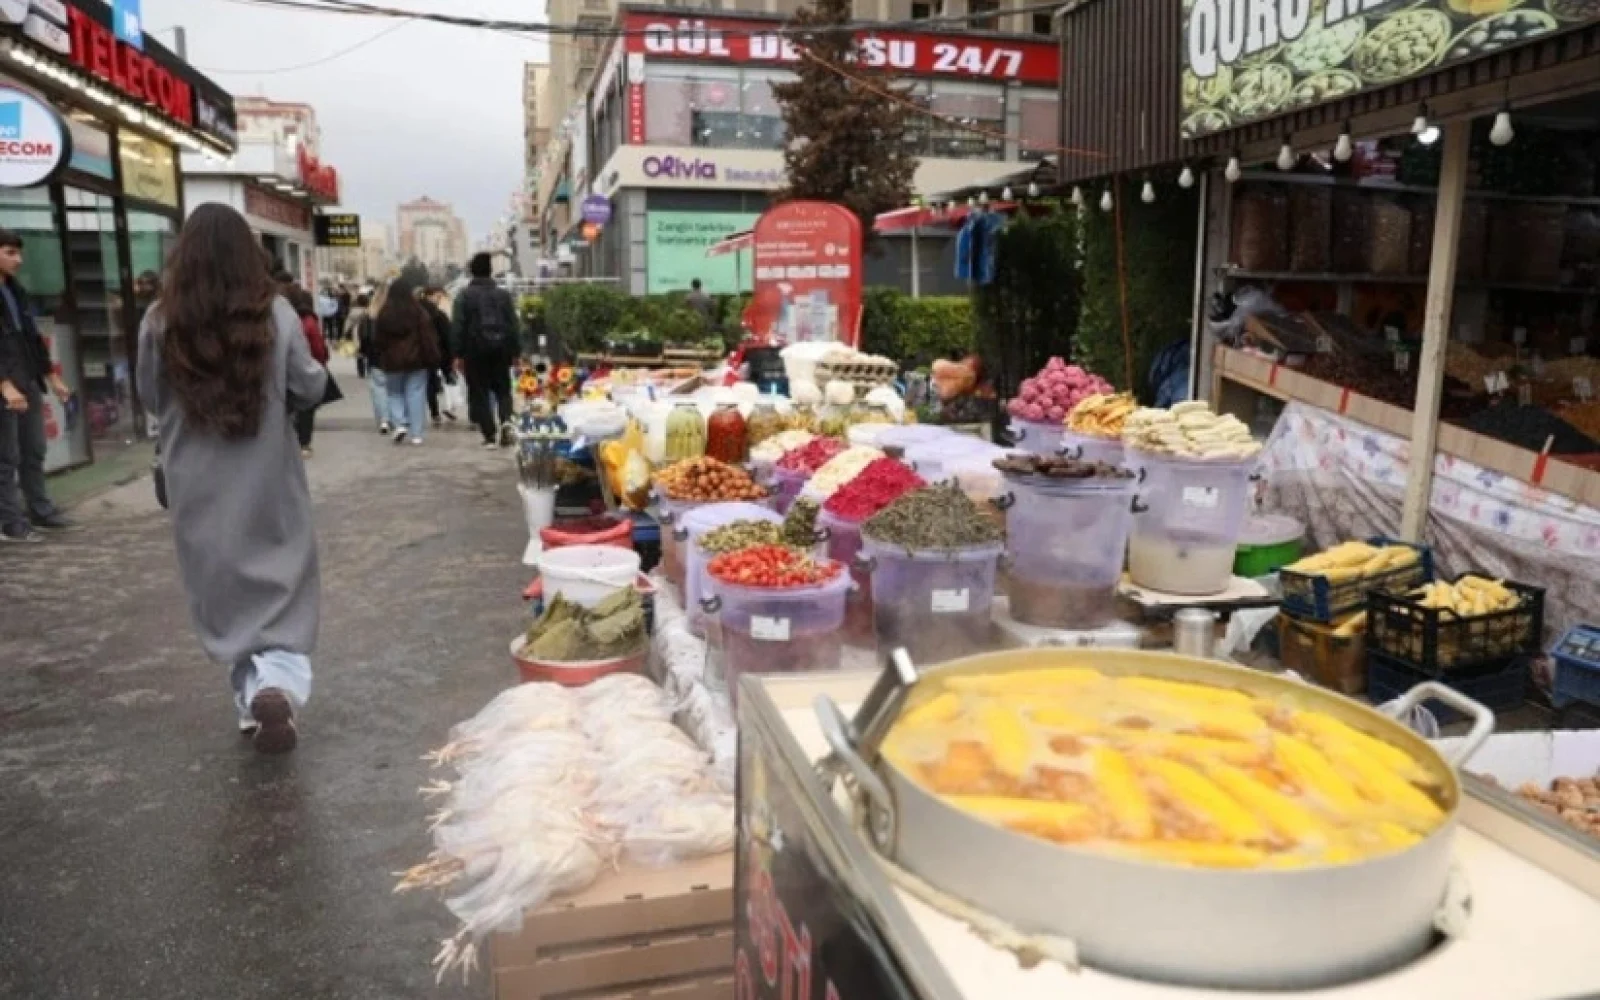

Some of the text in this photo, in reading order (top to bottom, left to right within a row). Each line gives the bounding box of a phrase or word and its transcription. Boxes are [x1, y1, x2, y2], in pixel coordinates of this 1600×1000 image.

[67, 4, 193, 128] TELECOM
[644, 19, 731, 57] GÜL
[931, 43, 1024, 77] 24/7
[1190, 0, 1309, 77] QURU
[643, 155, 717, 180] Olivia
